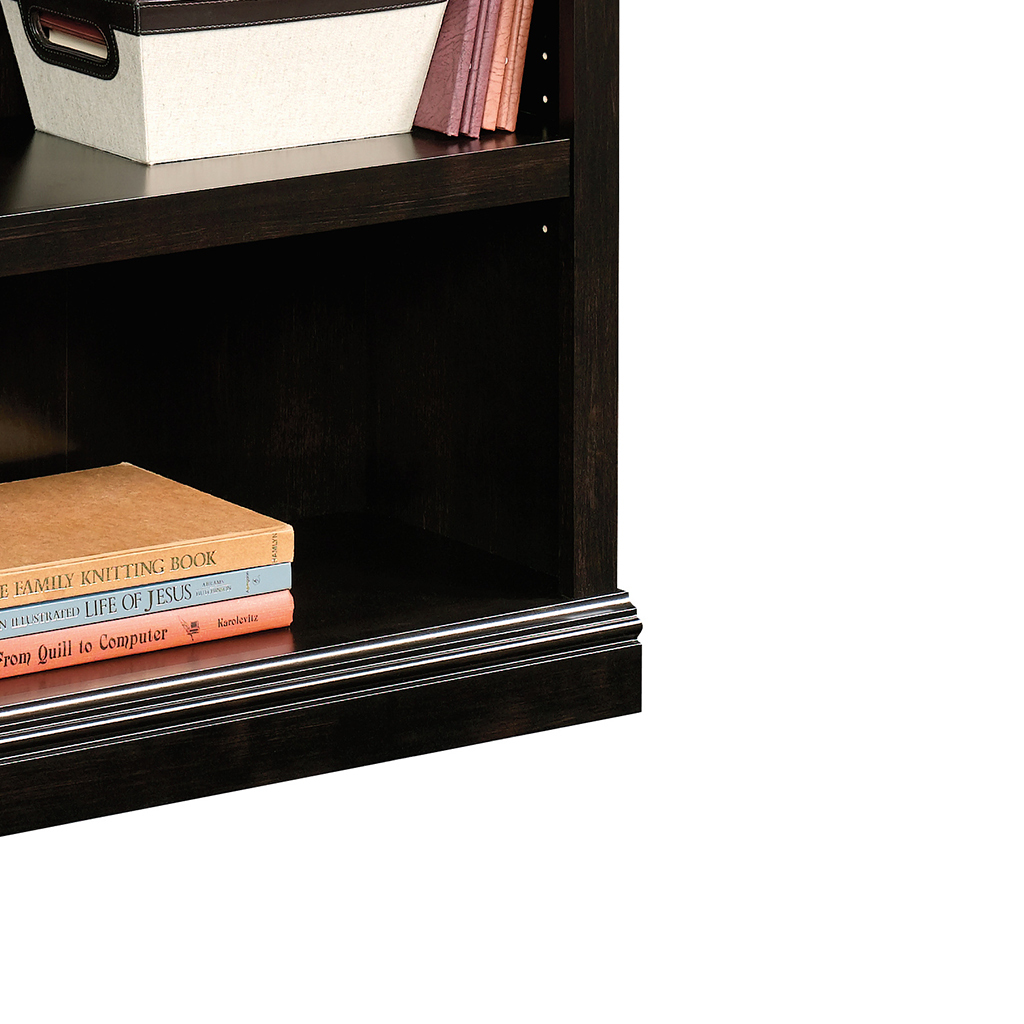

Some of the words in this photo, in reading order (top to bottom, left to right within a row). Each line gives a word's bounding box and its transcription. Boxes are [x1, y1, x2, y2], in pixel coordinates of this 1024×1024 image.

[13, 573, 74, 597] FAMILY
[80, 558, 165, 586] KNITTING
[169, 550, 217, 572] BOOK
[11, 607, 80, 628] ILLUSTRATED
[84, 597, 117, 618] LIFE
[121, 592, 142, 611] OF
[144, 583, 192, 612] JESUS
[217, 614, 259, 628] Karolevitz
[38, 640, 72, 665] Quill
[79, 640, 93, 654] to
[99, 628, 168, 651] Computer
